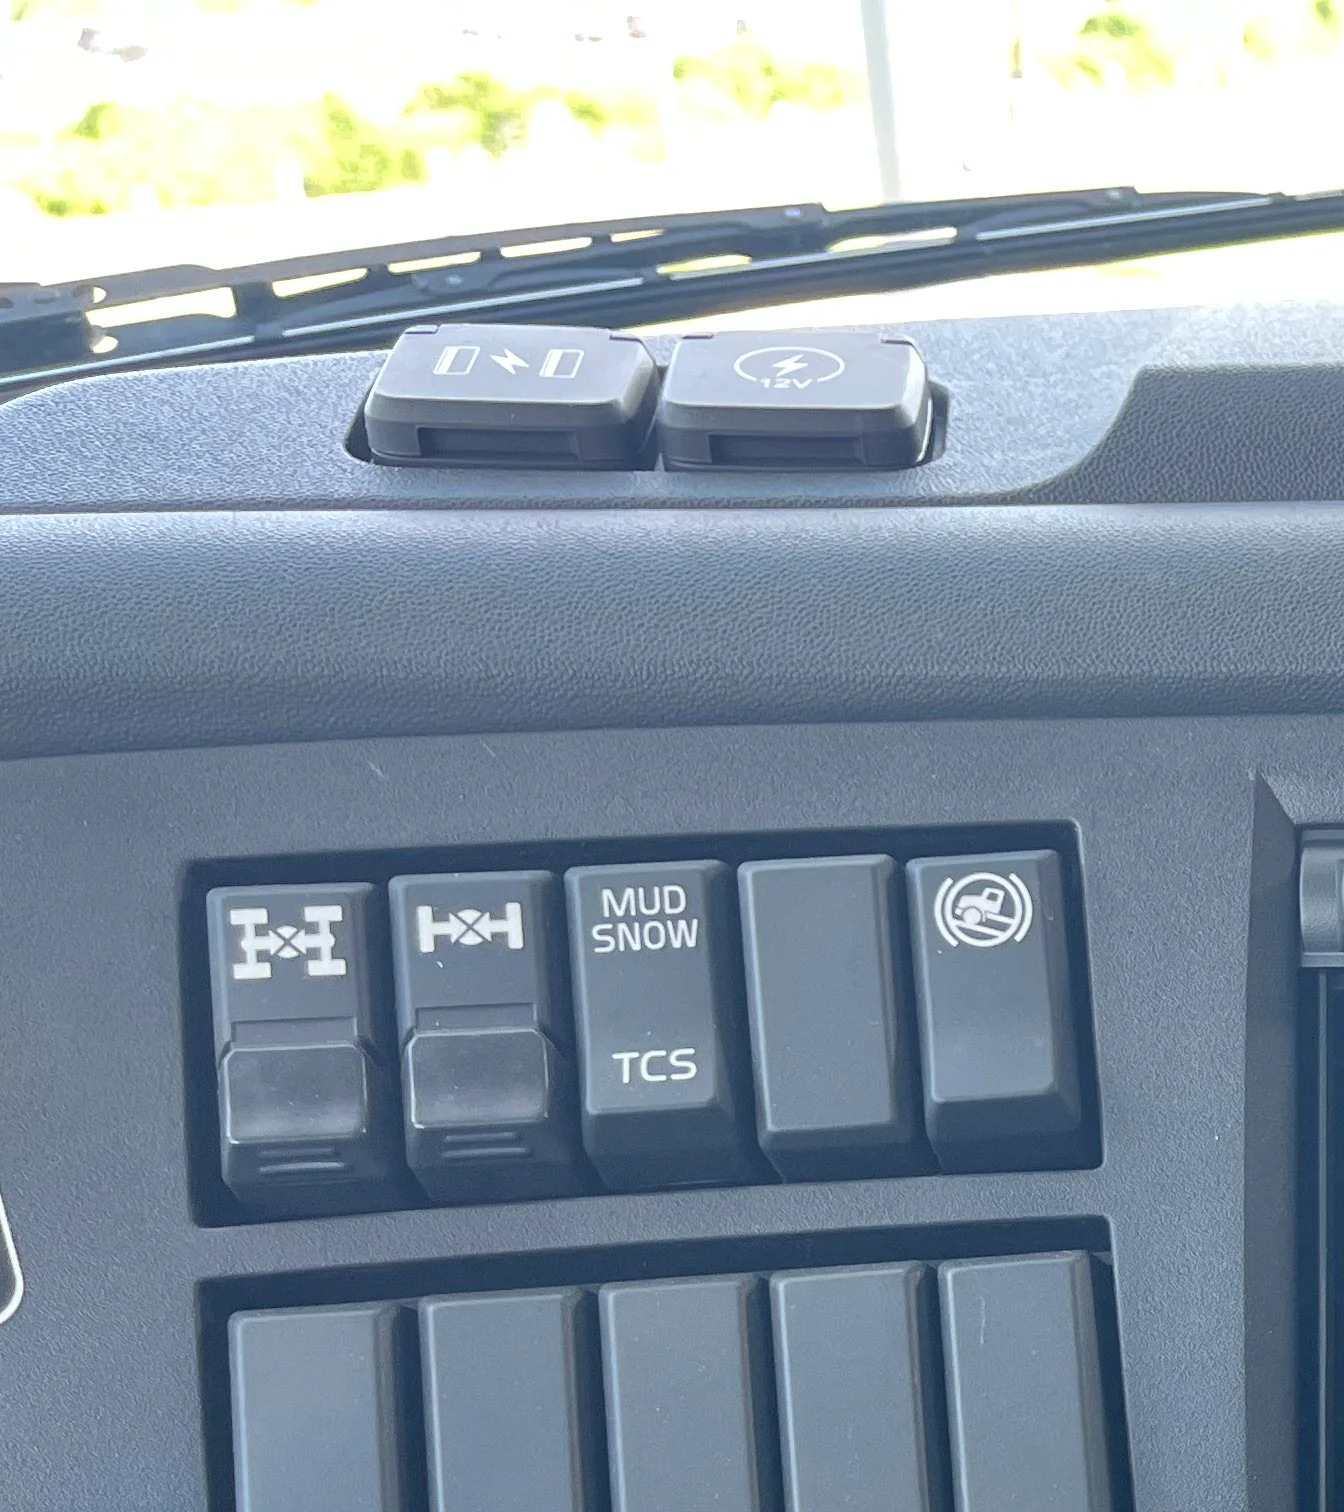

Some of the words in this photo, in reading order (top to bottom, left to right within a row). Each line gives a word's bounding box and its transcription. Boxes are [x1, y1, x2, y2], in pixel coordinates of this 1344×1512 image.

[759, 378, 813, 389] 12V
[602, 885, 687, 919] MUD
[591, 918, 700, 954] SNOW
[612, 1048, 698, 1084] TCS
